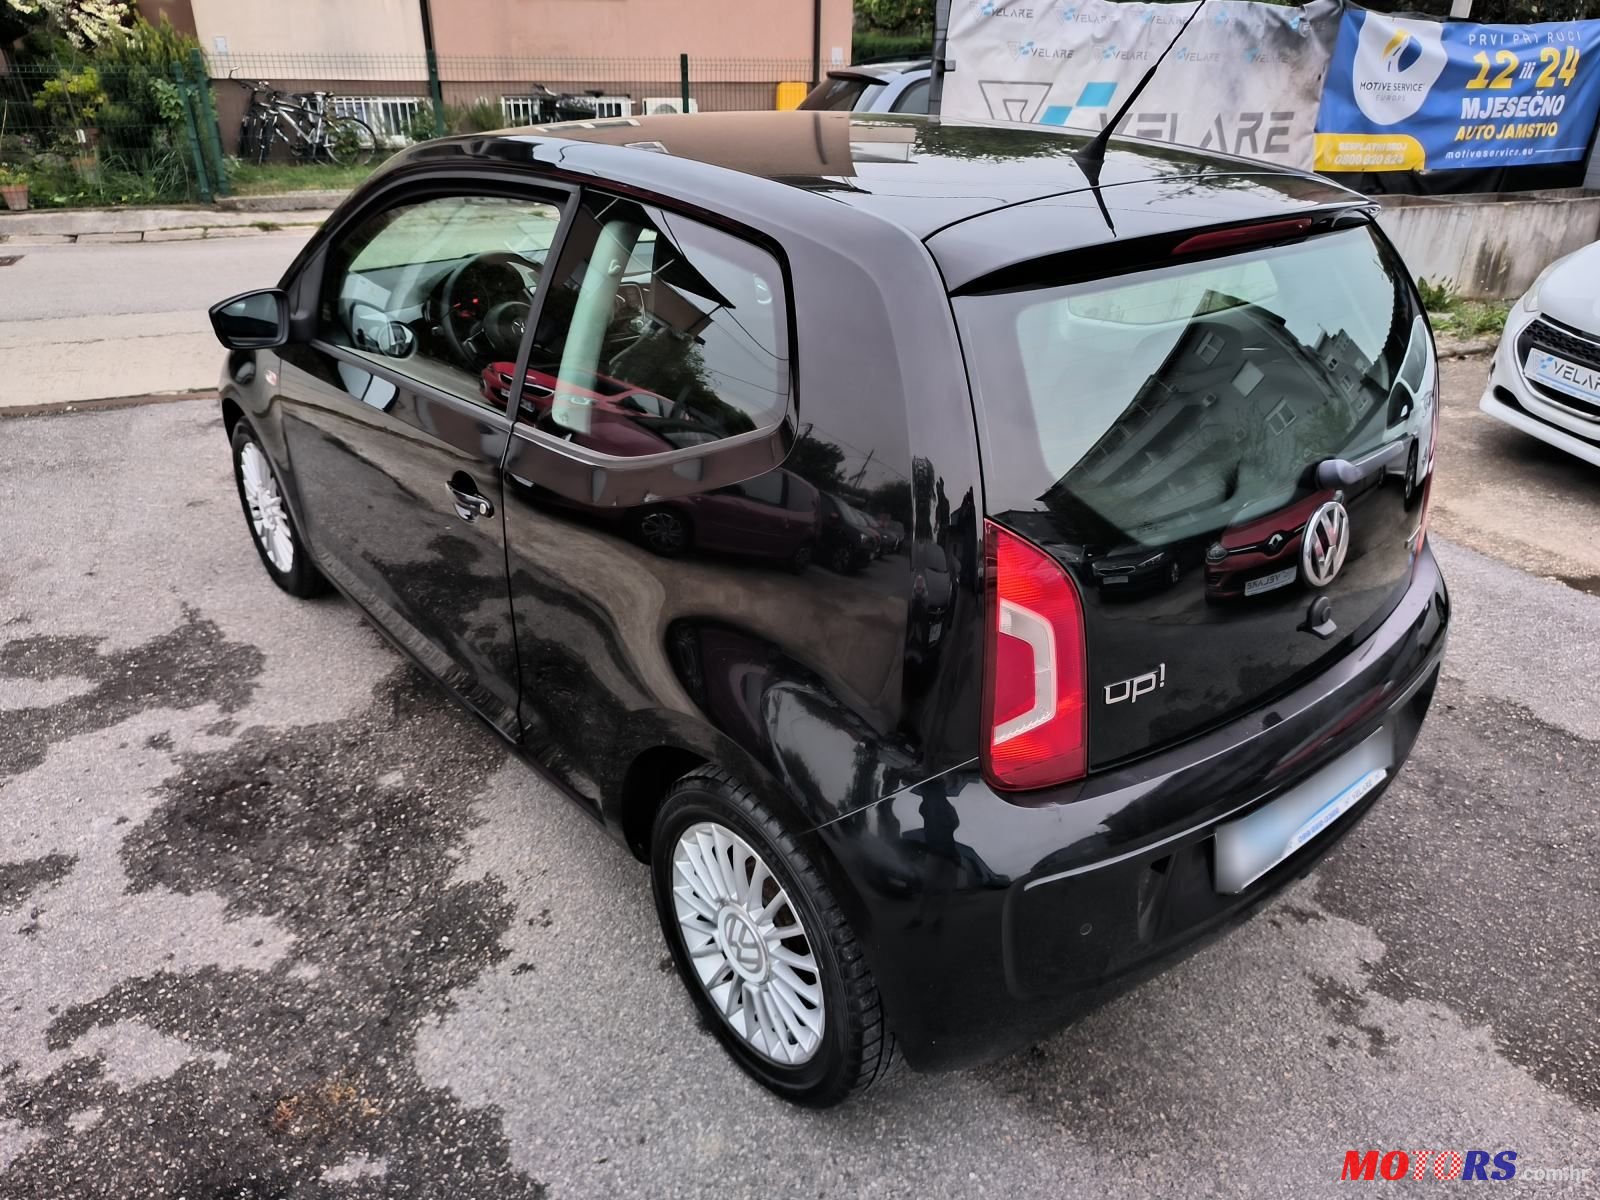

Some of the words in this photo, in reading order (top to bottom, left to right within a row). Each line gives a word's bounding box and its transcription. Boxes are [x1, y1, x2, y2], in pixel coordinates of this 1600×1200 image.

[991, 7, 1034, 19] VELARE
[1468, 33, 1504, 46] PRVI
[1512, 33, 1540, 44] PRI
[1547, 30, 1581, 43] RUCI
[1030, 47, 1075, 59] VELARE
[1465, 49, 1519, 89] 12
[1518, 61, 1537, 79] ili
[1535, 45, 1581, 88] 24
[1360, 81, 1392, 91] MOTIVE
[1393, 82, 1424, 92] SERVICE
[1460, 90, 1566, 120] MJESEČNO
[1454, 124, 1496, 142] AUTO
[1495, 122, 1559, 140] JAMSTVO
[1445, 147, 1534, 160] motiveservice.eu
[1104, 663, 1165, 705] up!
